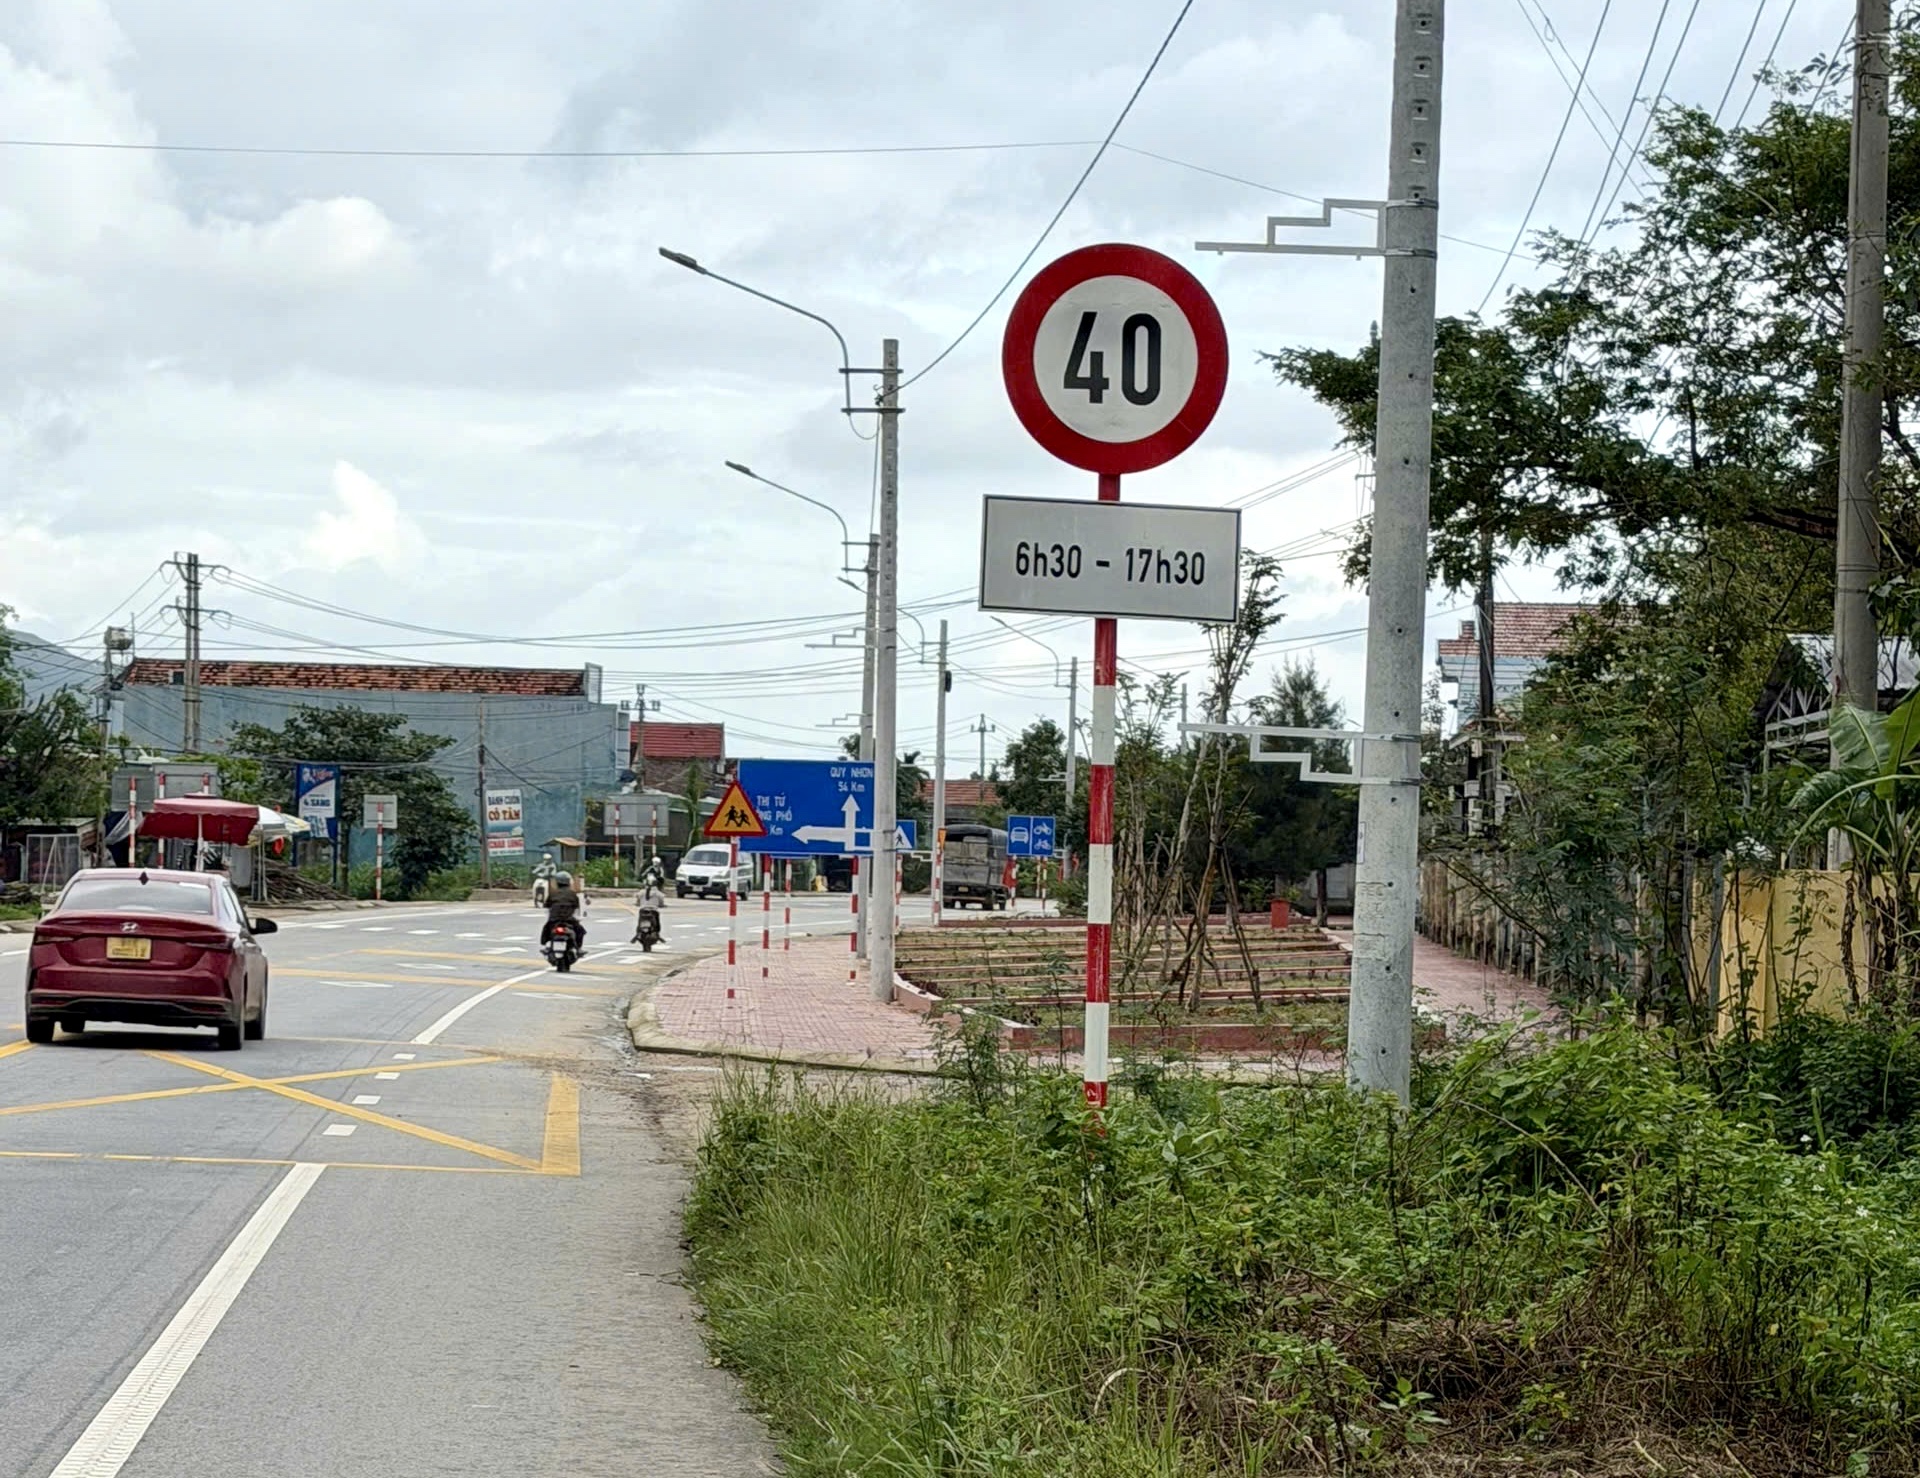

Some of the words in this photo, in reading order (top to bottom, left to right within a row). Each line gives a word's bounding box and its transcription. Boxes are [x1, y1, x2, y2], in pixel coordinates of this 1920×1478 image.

[1063, 311, 1162, 406] 40
[1015, 541, 1082, 579] 6h30
[1095, 558, 1111, 569] -
[1124, 547, 1206, 586] 17h30
[830, 767, 847, 778] QUY
[838, 781, 849, 792] 54
[851, 781, 865, 792] Km
[770, 823, 784, 836] Km
